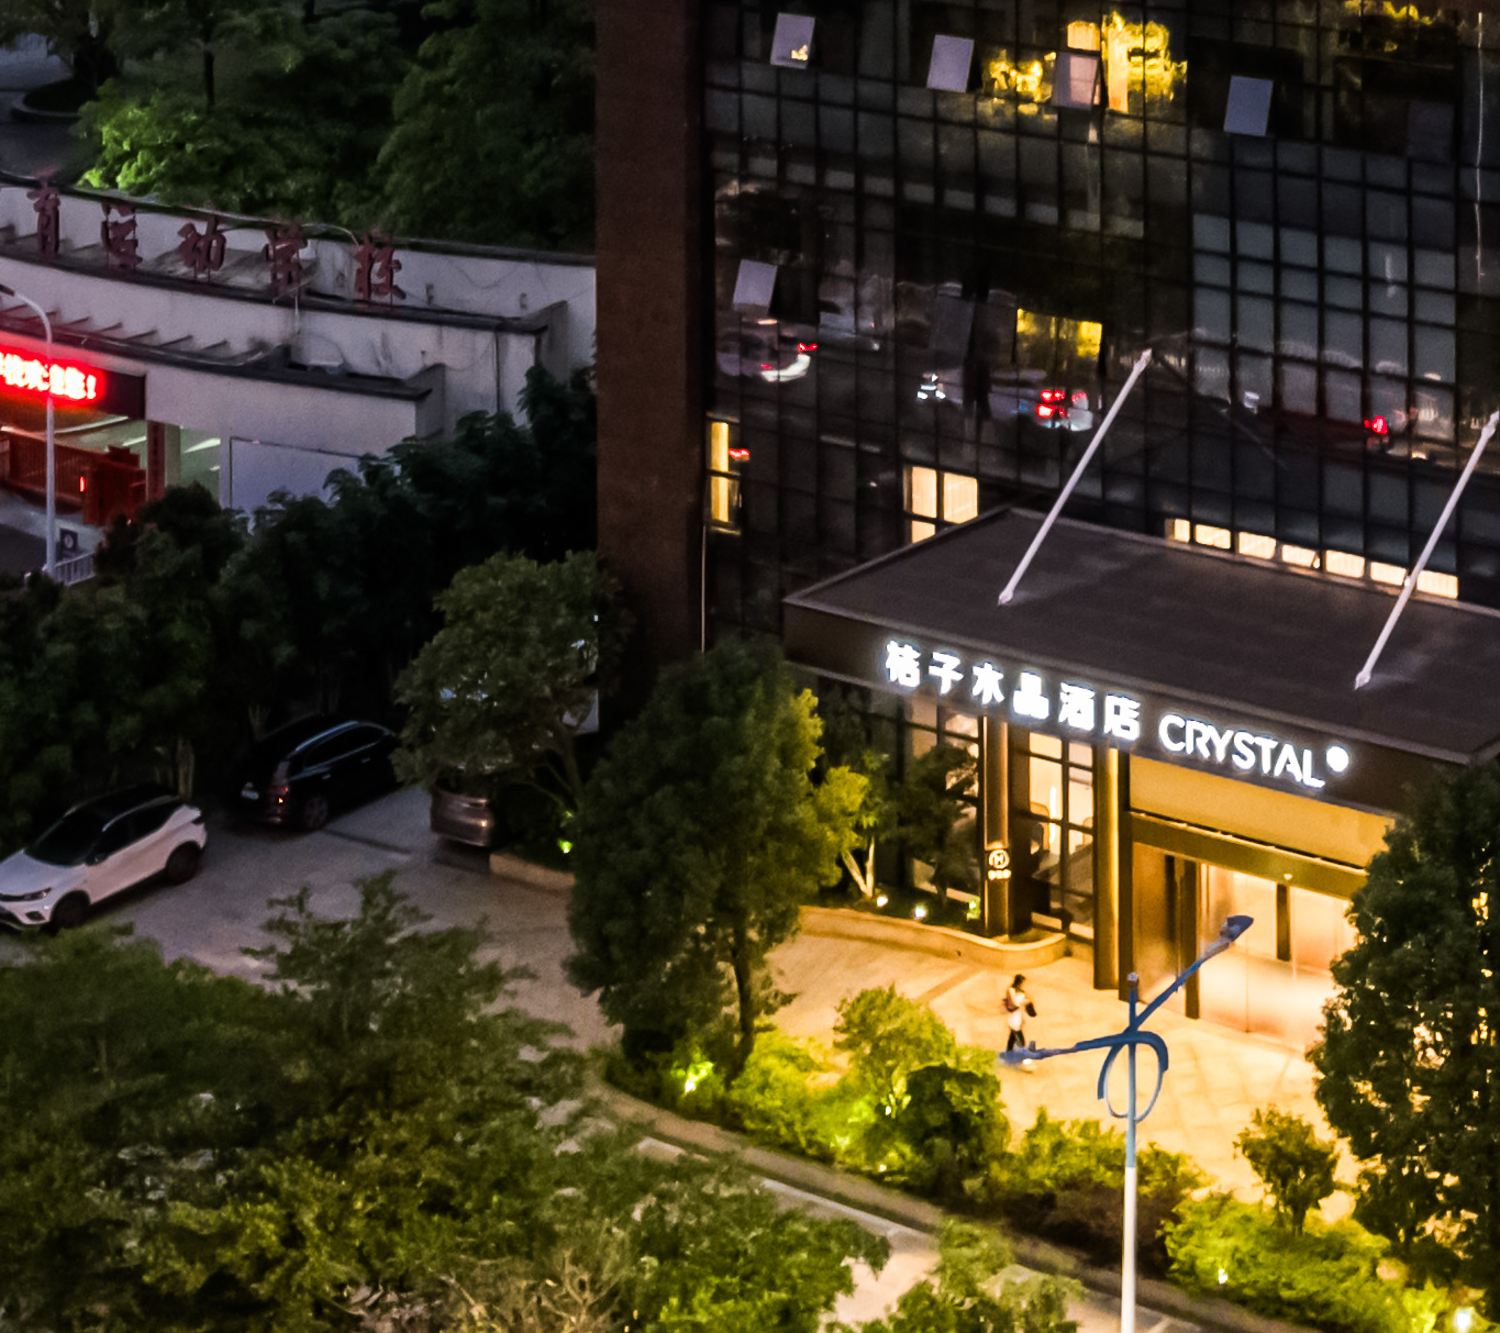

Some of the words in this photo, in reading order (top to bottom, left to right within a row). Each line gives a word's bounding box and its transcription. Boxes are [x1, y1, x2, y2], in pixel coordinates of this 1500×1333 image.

[885, 639, 1142, 743] 桔子水晶酒店
[1158, 712, 1327, 789] CRYSTAL
